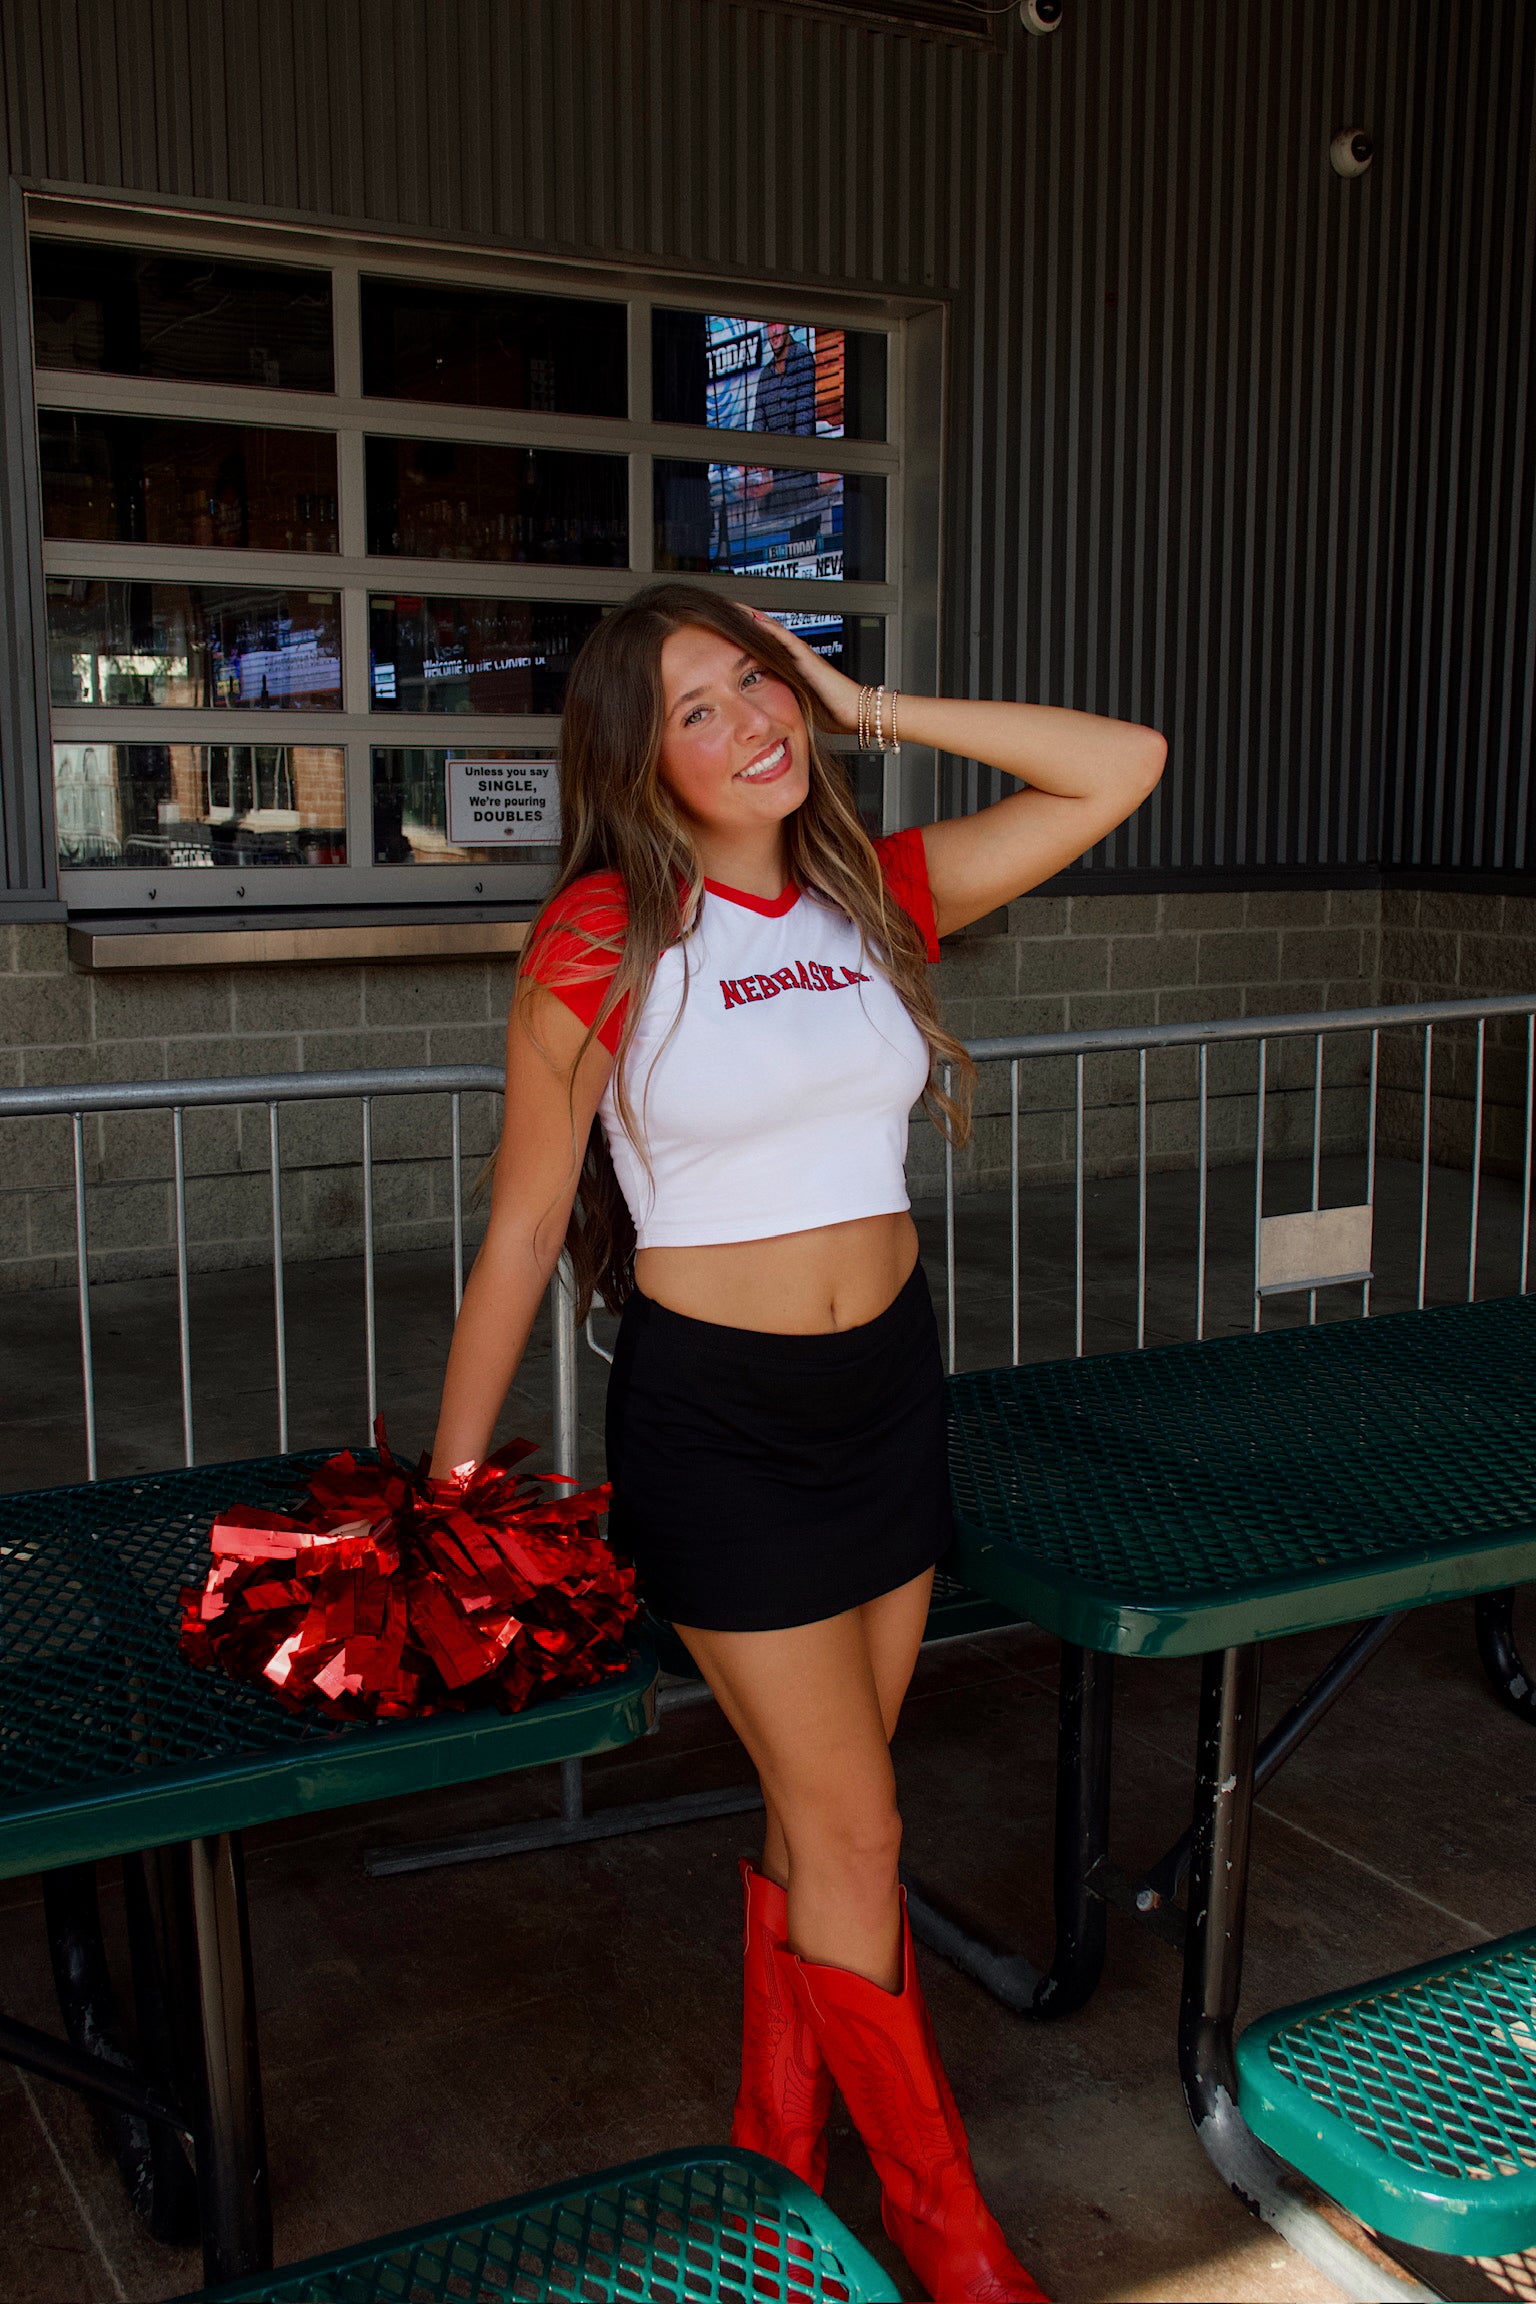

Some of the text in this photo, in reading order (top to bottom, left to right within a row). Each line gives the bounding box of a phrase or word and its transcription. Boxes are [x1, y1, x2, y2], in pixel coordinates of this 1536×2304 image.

[705, 335, 760, 379] TODAY
[788, 538, 816, 557] TODAY
[465, 767, 549, 778] Unless you say
[478, 780, 537, 793] SINGLE,
[469, 796, 546, 808] We're pouring
[473, 811, 543, 822] DOUBLES
[719, 960, 870, 1010] NEBRASKA
